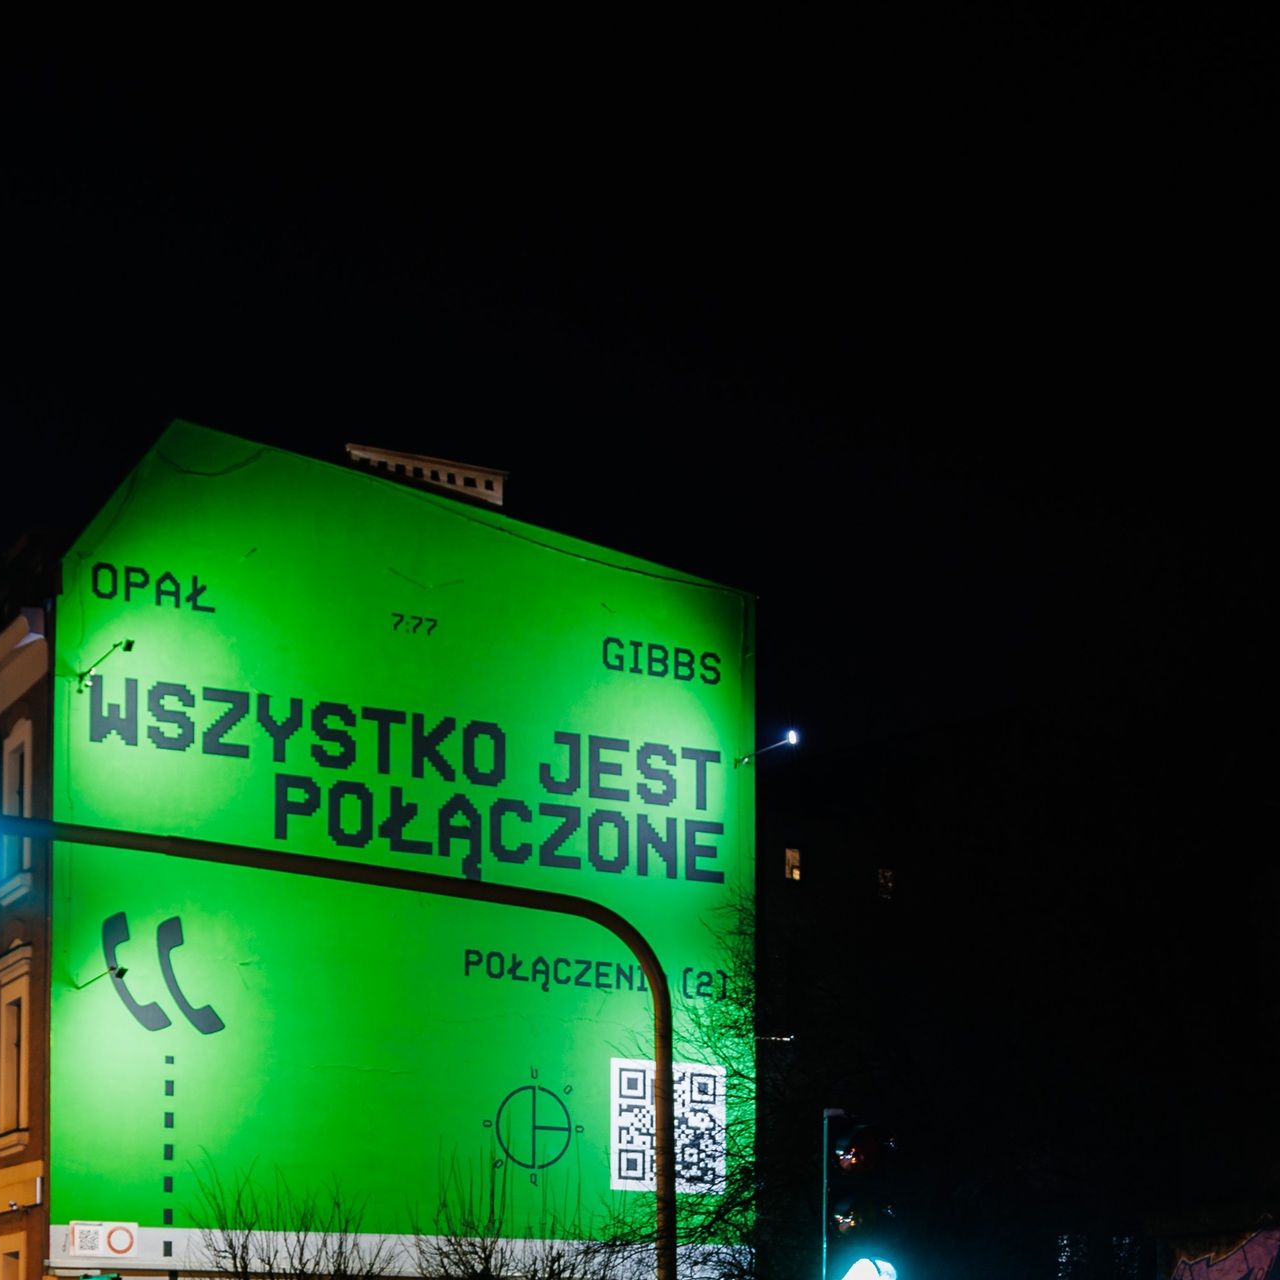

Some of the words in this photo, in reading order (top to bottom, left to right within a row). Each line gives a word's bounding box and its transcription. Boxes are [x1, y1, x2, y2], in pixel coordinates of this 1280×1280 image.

[91, 562, 216, 613] OPAŁ
[391, 612, 437, 637] 7:77
[602, 636, 721, 685] GIBBS
[89, 675, 505, 787] WSZYSTKO
[539, 731, 721, 811] JEST
[274, 773, 725, 883] POŁĄCZONE
[464, 949, 668, 992] POŁĄCZENI
